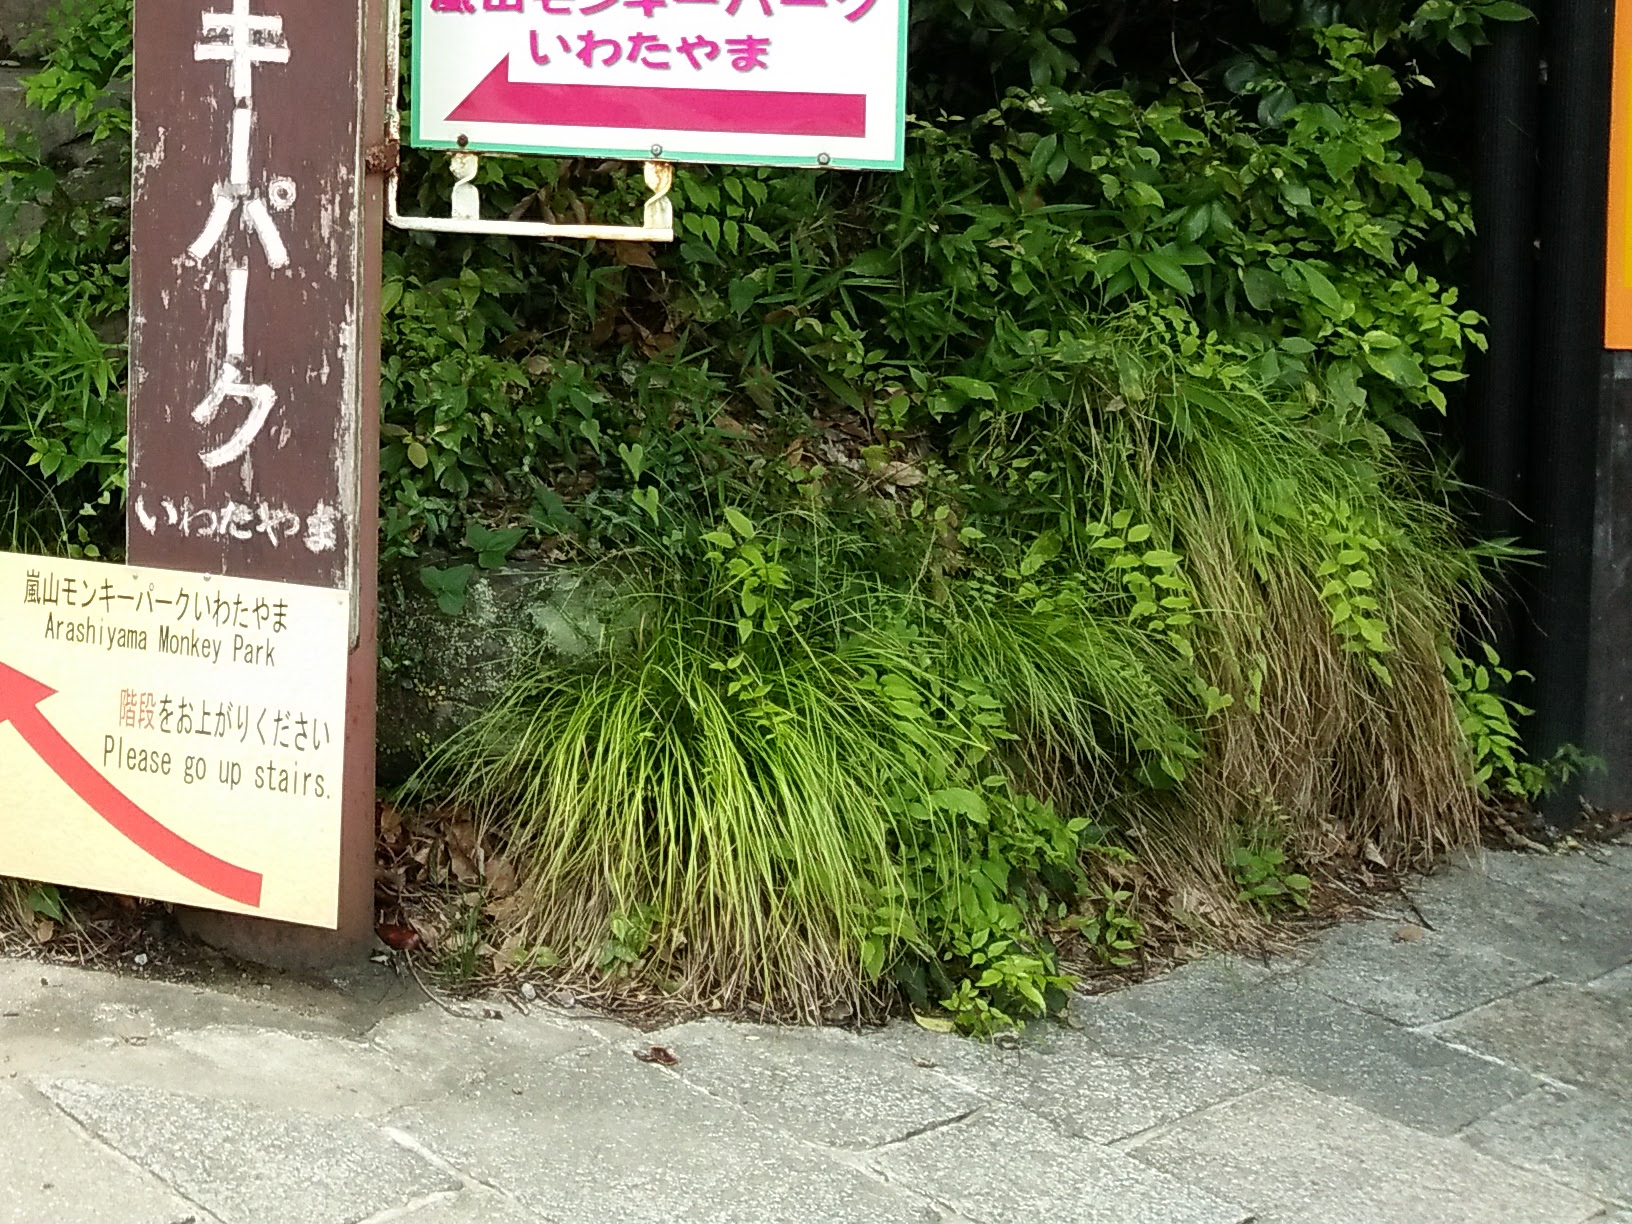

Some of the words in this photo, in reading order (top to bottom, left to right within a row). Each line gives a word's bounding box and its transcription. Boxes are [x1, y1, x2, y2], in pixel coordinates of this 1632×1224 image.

[529, 29, 771, 73] いわたやま
[135, 496, 340, 554] いわたやま
[23, 569, 289, 633] 嵐山モンキーパークいわたやま
[45, 612, 147, 651] Arashiyama
[158, 625, 221, 664] Monkey
[233, 633, 276, 667] Park
[119, 688, 330, 752] 階段をお上がりください
[103, 734, 171, 776] Please
[183, 756, 207, 785] go
[219, 761, 242, 790] up
[254, 761, 331, 799] stairs.
